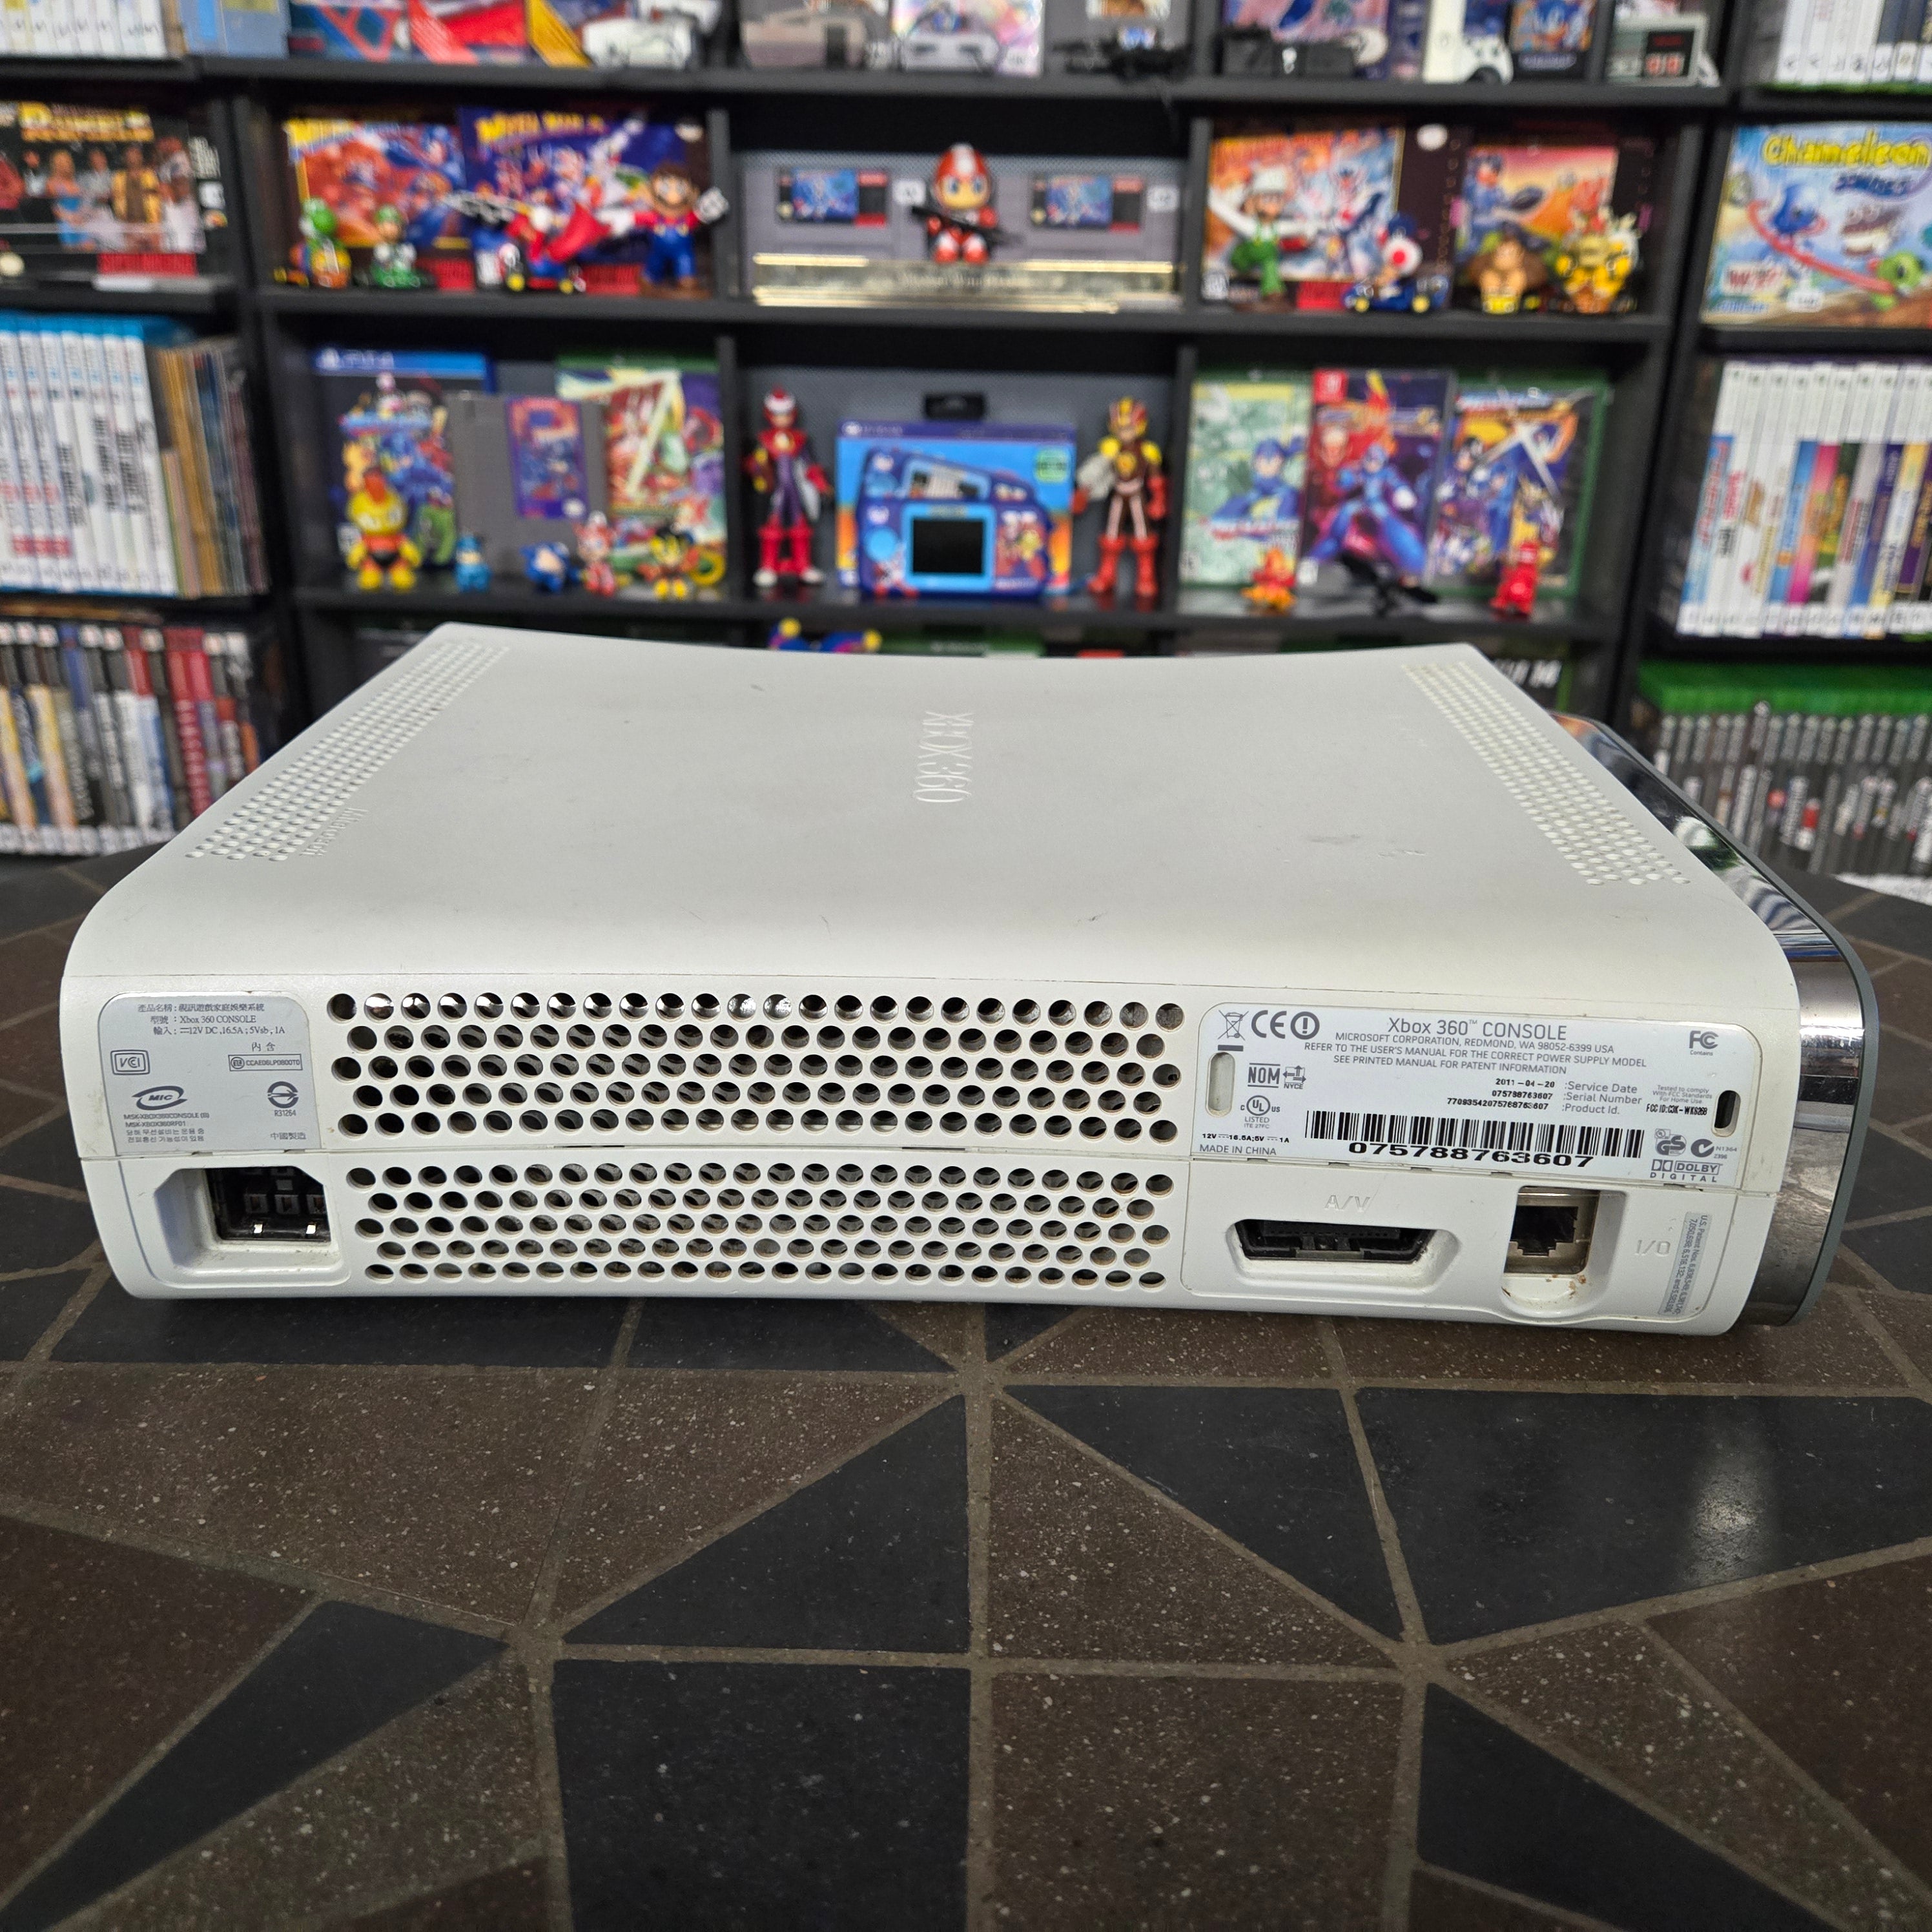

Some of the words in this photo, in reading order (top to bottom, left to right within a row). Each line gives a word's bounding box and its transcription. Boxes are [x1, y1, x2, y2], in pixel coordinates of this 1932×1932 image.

[180, 1015, 200, 1023] Xbox
[201, 1015, 214, 1023] 360
[216, 1015, 256, 1023] CONSOLE
[1388, 1017, 1431, 1034] Xbox
[1483, 1022, 1567, 1040] CONSOLE
[1335, 1033, 1390, 1043] MICROSOFT
[1393, 1034, 1461, 1047] CORPORATION,
[1464, 1038, 1516, 1049] REDMOND,
[1519, 1041, 1535, 1050] WA
[1537, 1042, 1592, 1053] 98052-6399
[1595, 1045, 1614, 1053] USA
[1304, 1042, 1332, 1051] REFER
[1335, 1043, 1347, 1052] TO
[1350, 1044, 1368, 1053] THE
[1370, 1045, 1403, 1054] USER'S
[1405, 1047, 1446, 1057] MANUAL
[1450, 1049, 1468, 1058] FOR
[1470, 1050, 1488, 1059] THE
[1491, 1051, 1534, 1061] CORRECT
[1537, 1054, 1570, 1064] POWER
[1574, 1055, 1609, 1065] SUPPLY
[1612, 1058, 1647, 1067] MODEL
[1333, 1055, 1350, 1064] SEE
[1353, 1056, 1393, 1065] PRINTED
[1396, 1058, 1437, 1067] MANUAL
[1441, 1060, 1458, 1069] FOR
[1461, 1062, 1495, 1071] PATENT
[1499, 1063, 1567, 1074] INFORMATION
[1248, 1067, 1280, 1085] NOM
[1612, 1084, 1638, 1094] Date
[1599, 1094, 1642, 1104] Number
[1608, 1105, 1619, 1115] Id.
[1646, 1103, 1658, 1113] FCC
[1200, 1144, 1229, 1153] MADE
[1246, 1146, 1277, 1155] CHINA
[1349, 1142, 1594, 1167] 075788763607
[1676, 1162, 1718, 1173] DOLBY
[1650, 1172, 1717, 1182] DIGITAL
[1324, 1195, 1371, 1212] A/V
[1697, 1215, 1708, 1228] U.S.
[1694, 1228, 1705, 1249] Patent
[1634, 1240, 1670, 1256] I/O
